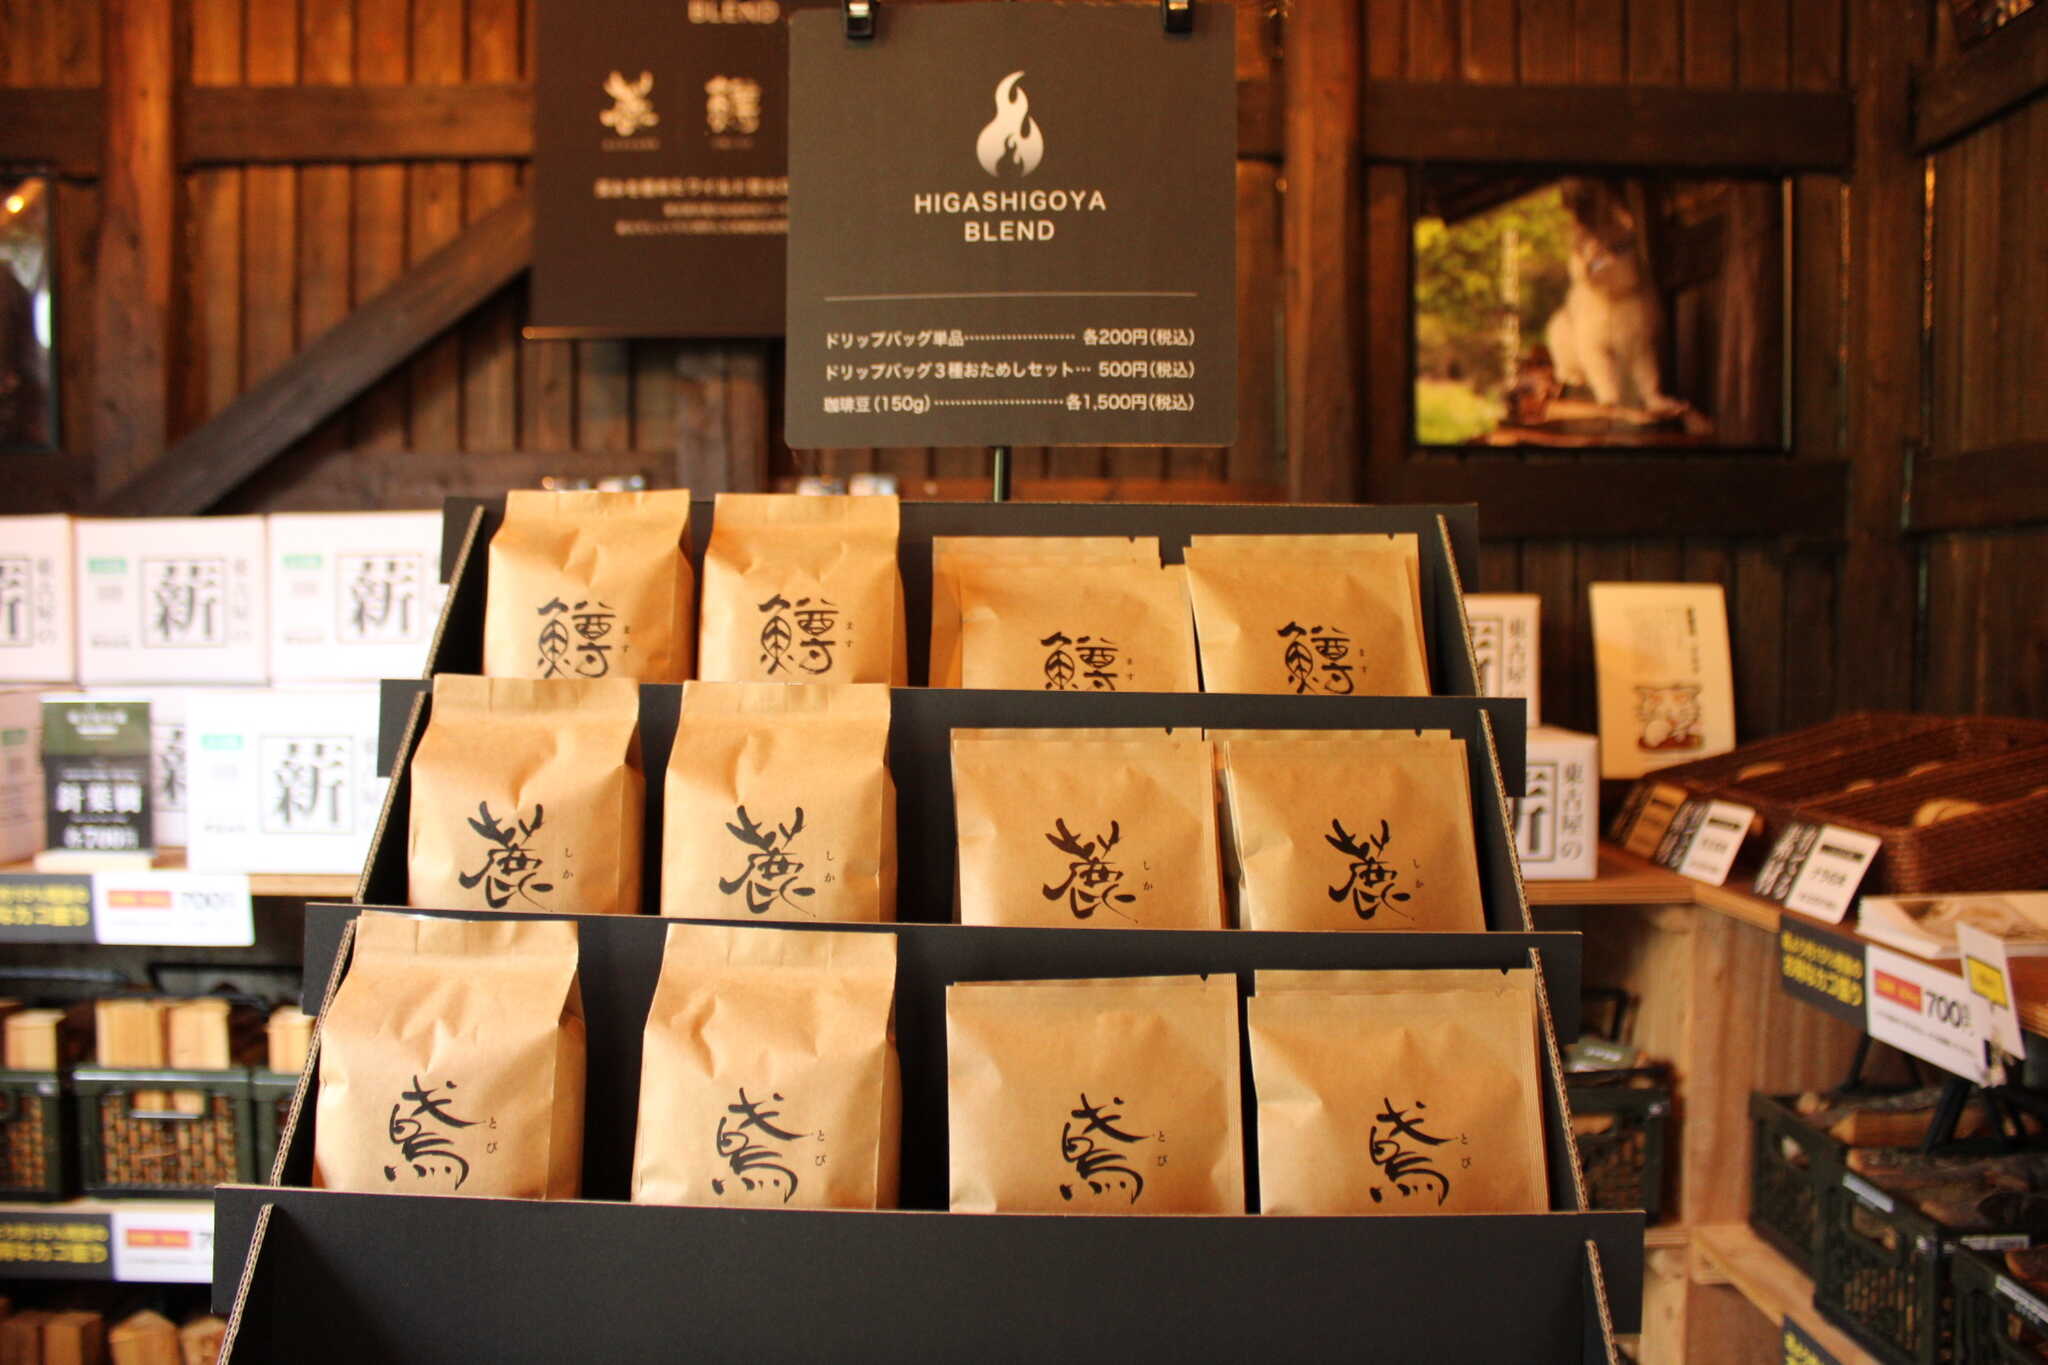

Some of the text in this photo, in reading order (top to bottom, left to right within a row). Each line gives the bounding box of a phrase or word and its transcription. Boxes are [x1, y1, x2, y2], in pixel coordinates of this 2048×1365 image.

[914, 190, 1107, 214] HIGASHIGOYA
[964, 220, 1055, 242] BLEND
[1098, 361, 1196, 380] 500円(税込)
